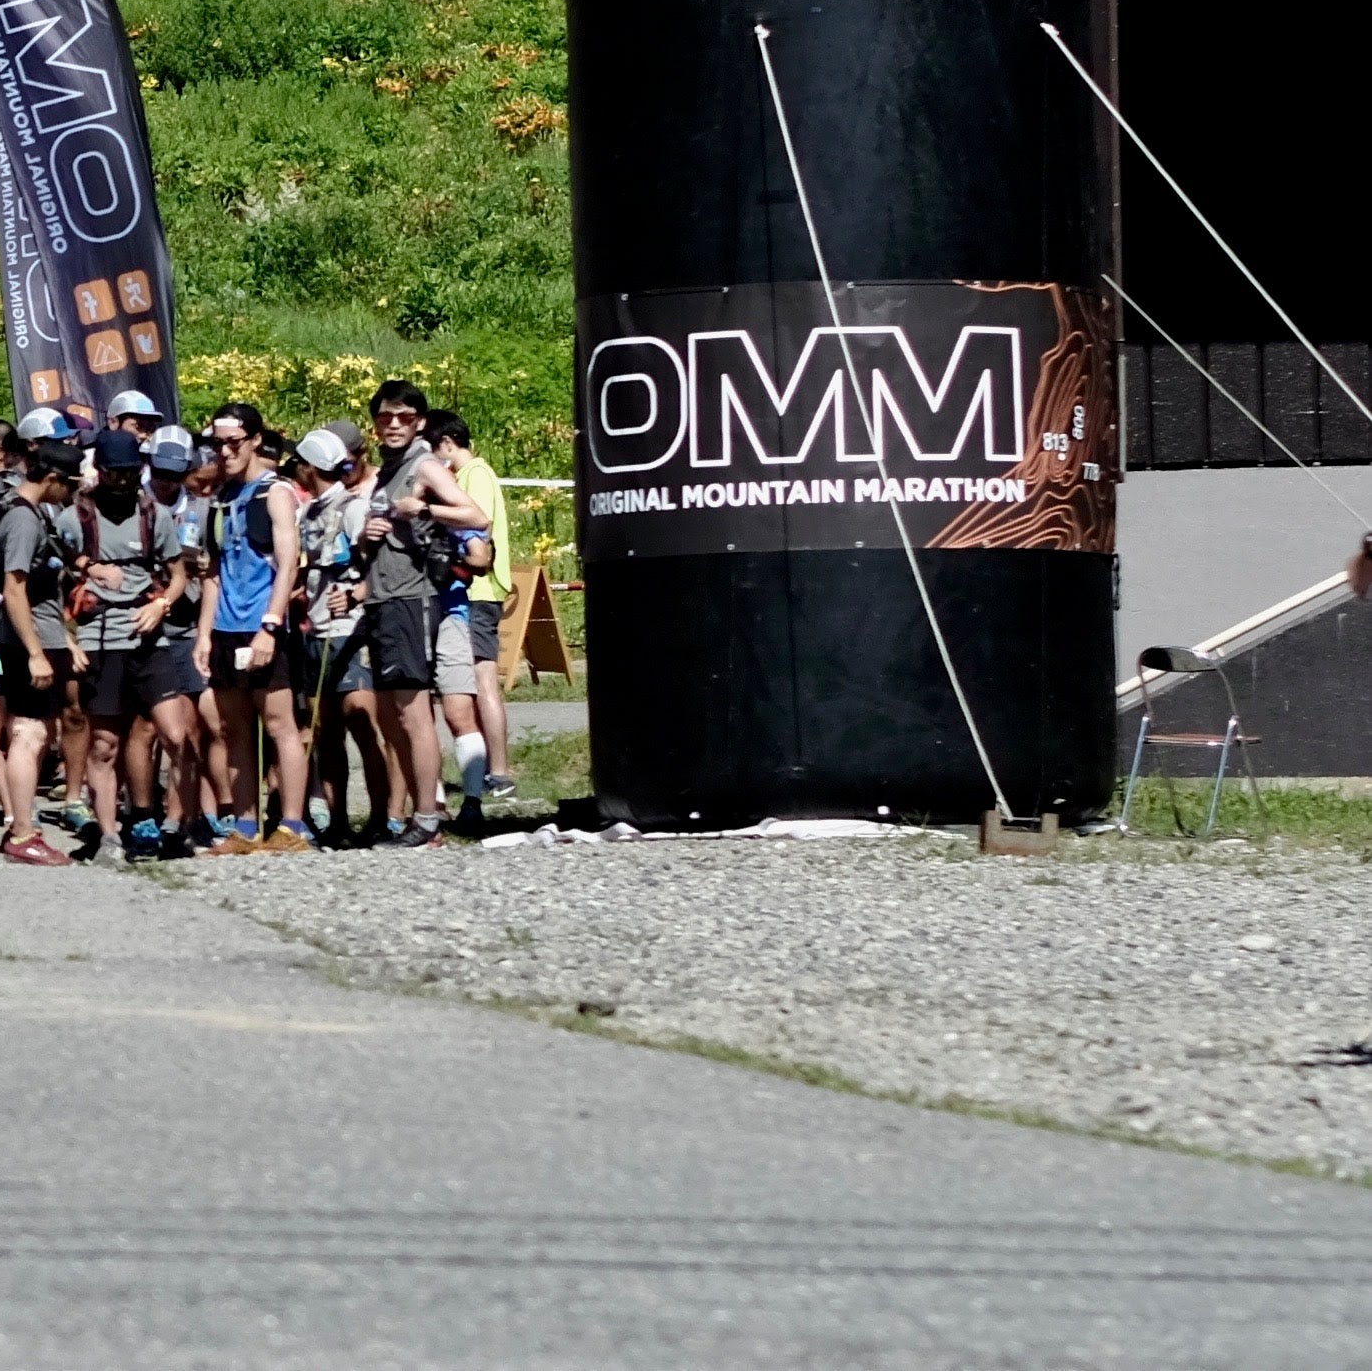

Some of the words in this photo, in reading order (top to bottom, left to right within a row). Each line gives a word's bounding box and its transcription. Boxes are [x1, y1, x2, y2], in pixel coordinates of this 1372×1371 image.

[587, 325, 1024, 474] OMM
[1043, 432, 1069, 451] 813
[590, 485, 677, 516] ORIGINAL
[682, 479, 846, 509] MOUNTAIN
[854, 477, 1026, 504] MARATHON
